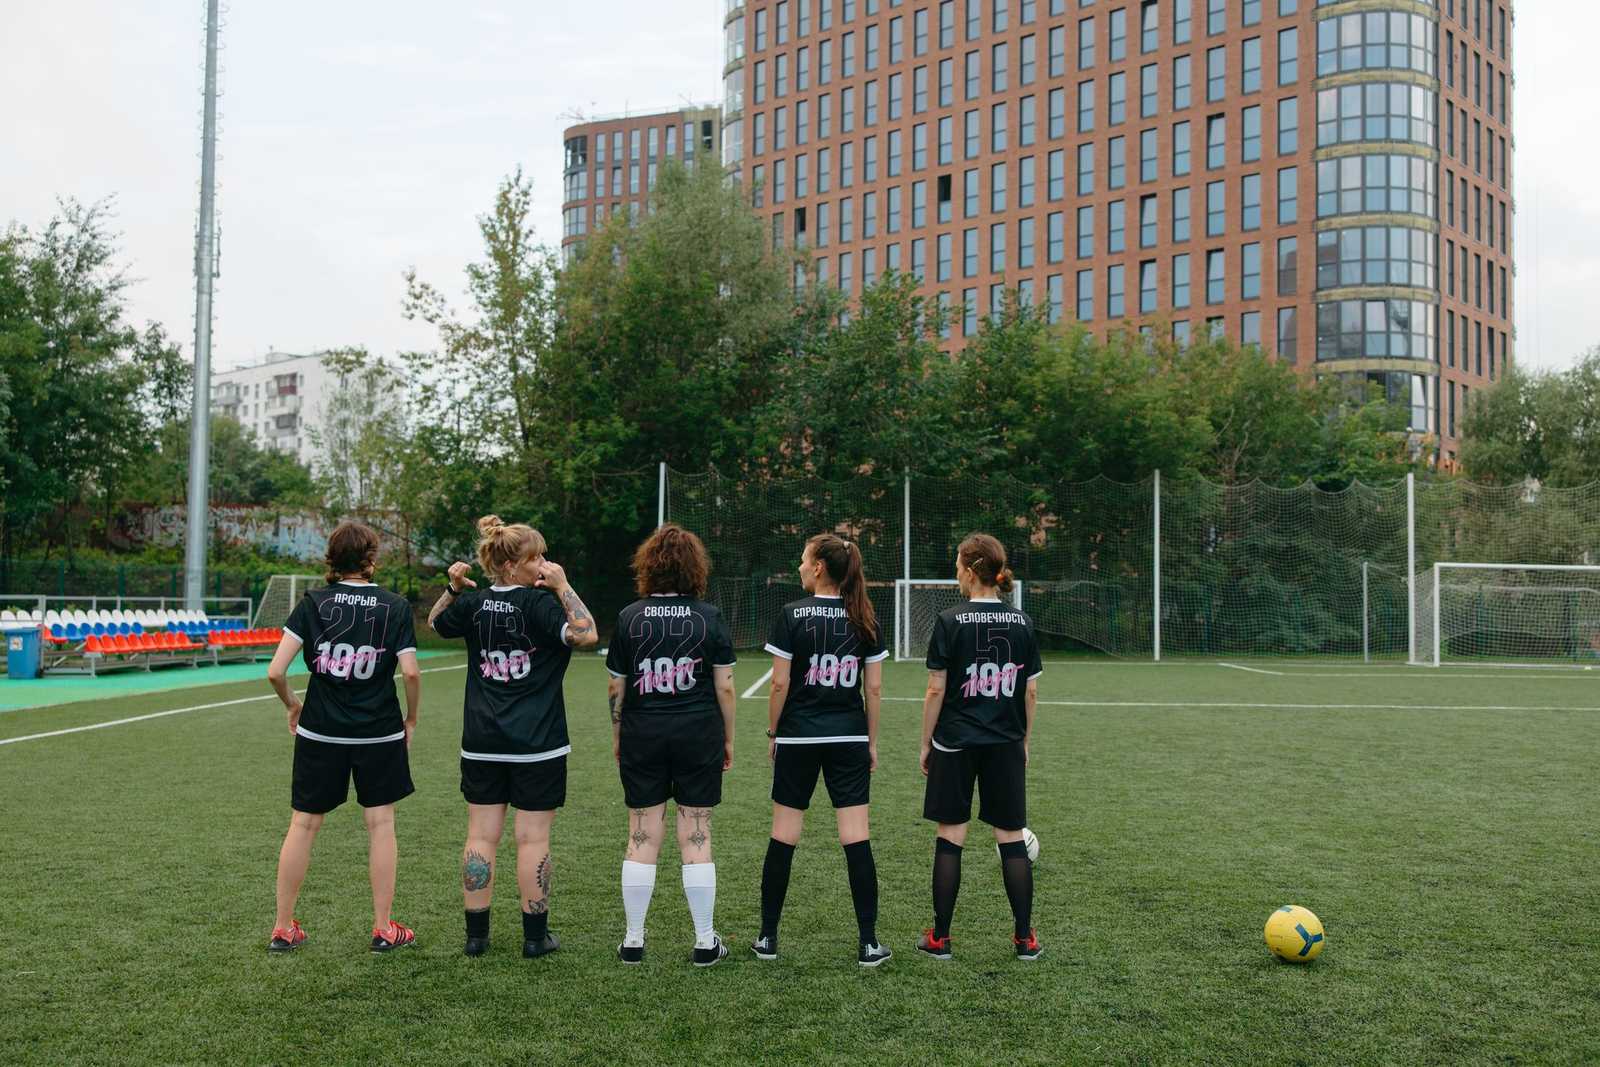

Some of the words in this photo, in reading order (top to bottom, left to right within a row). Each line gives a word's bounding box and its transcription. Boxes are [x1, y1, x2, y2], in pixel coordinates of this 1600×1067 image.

[334, 593, 378, 607] ПРОРЫВ
[644, 606, 692, 618] СВОБОДА
[793, 606, 849, 620] СПРАВЕДЛИ
[955, 612, 1026, 625] ЧЕЛОВЕЧНОСТЬ
[630, 610, 706, 674] 22
[975, 621, 1011, 664] 5
[318, 641, 377, 680] 100
[638, 657, 696, 694] 100
[809, 653, 858, 688] 100
[966, 662, 1018, 697] 100
